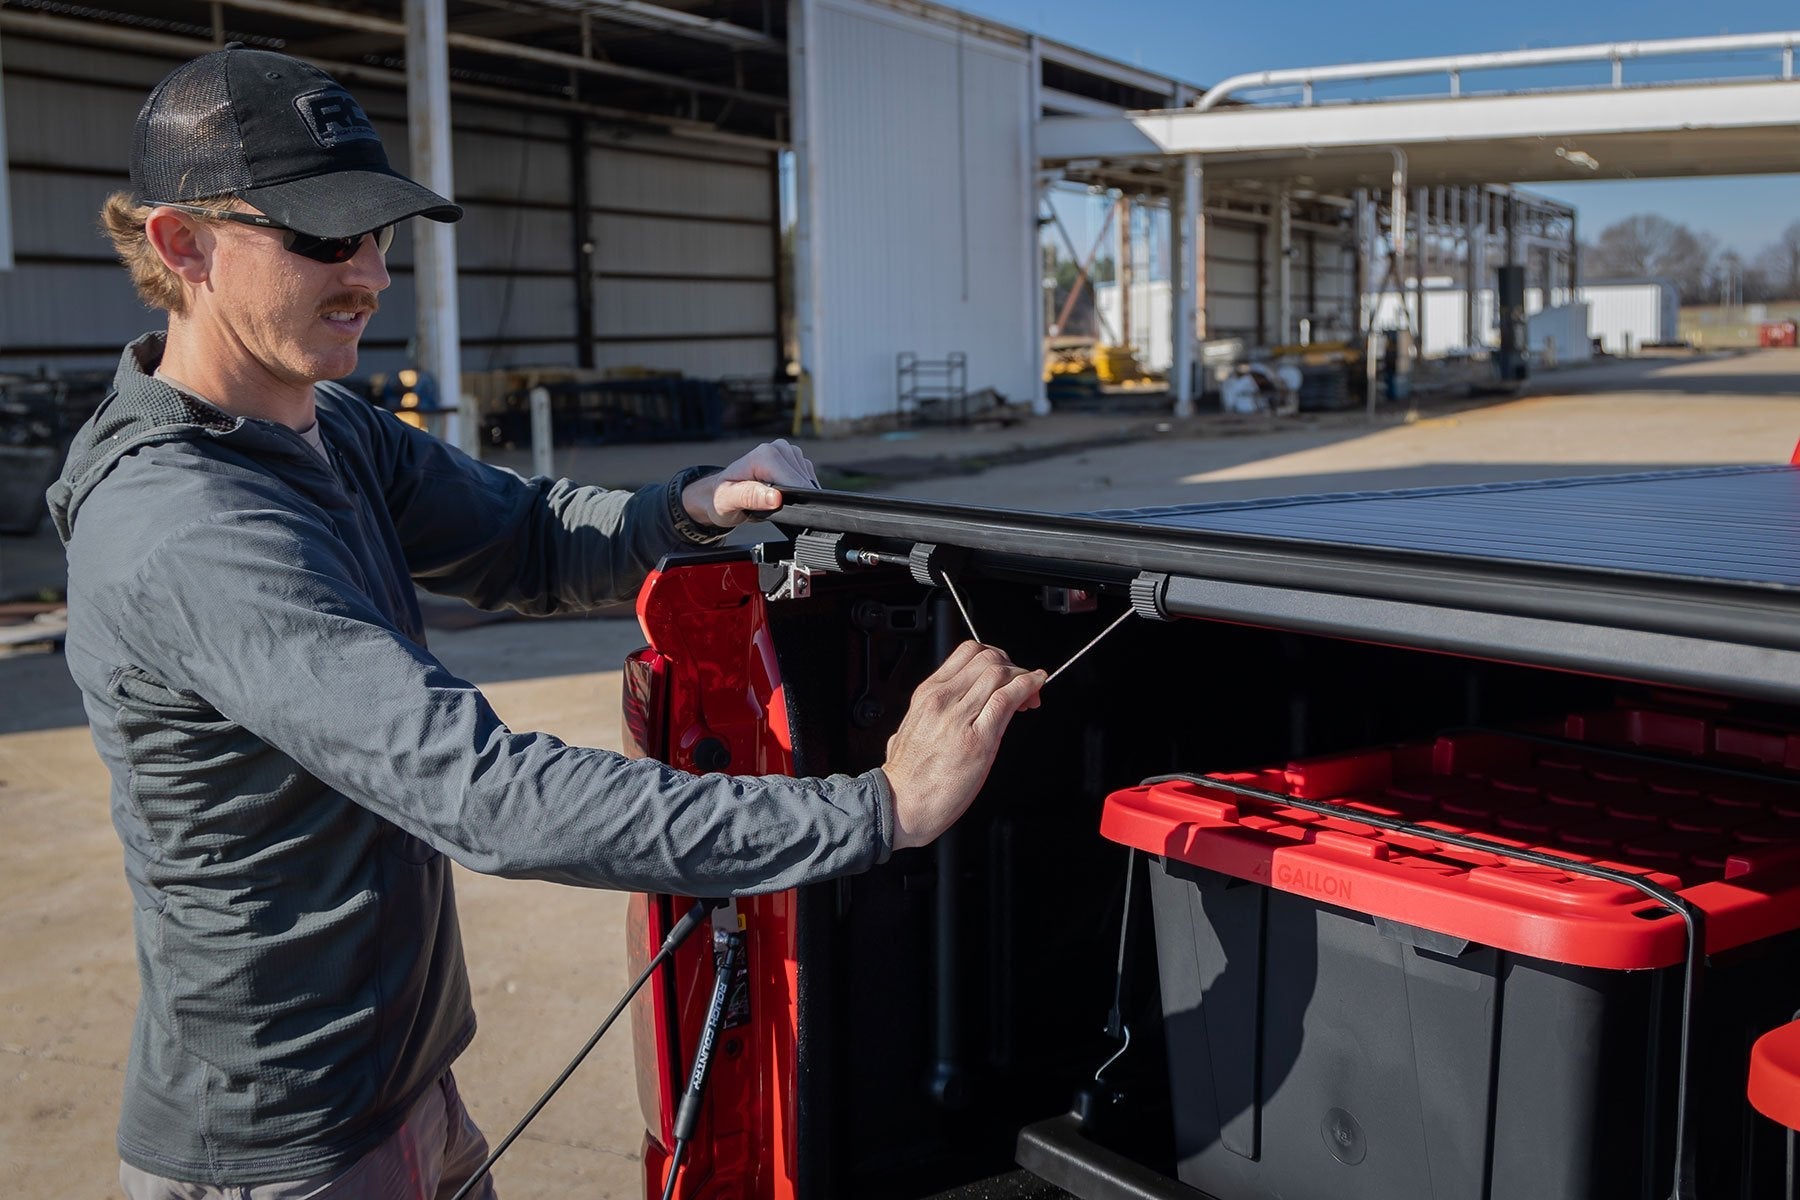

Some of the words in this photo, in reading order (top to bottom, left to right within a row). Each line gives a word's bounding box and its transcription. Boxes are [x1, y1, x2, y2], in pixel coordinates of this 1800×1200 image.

[1252, 859, 1271, 877] 27
[1278, 863, 1352, 900] GALLON
[709, 982, 727, 1027] ROUGH
[693, 1027, 715, 1090] COUNTRY
